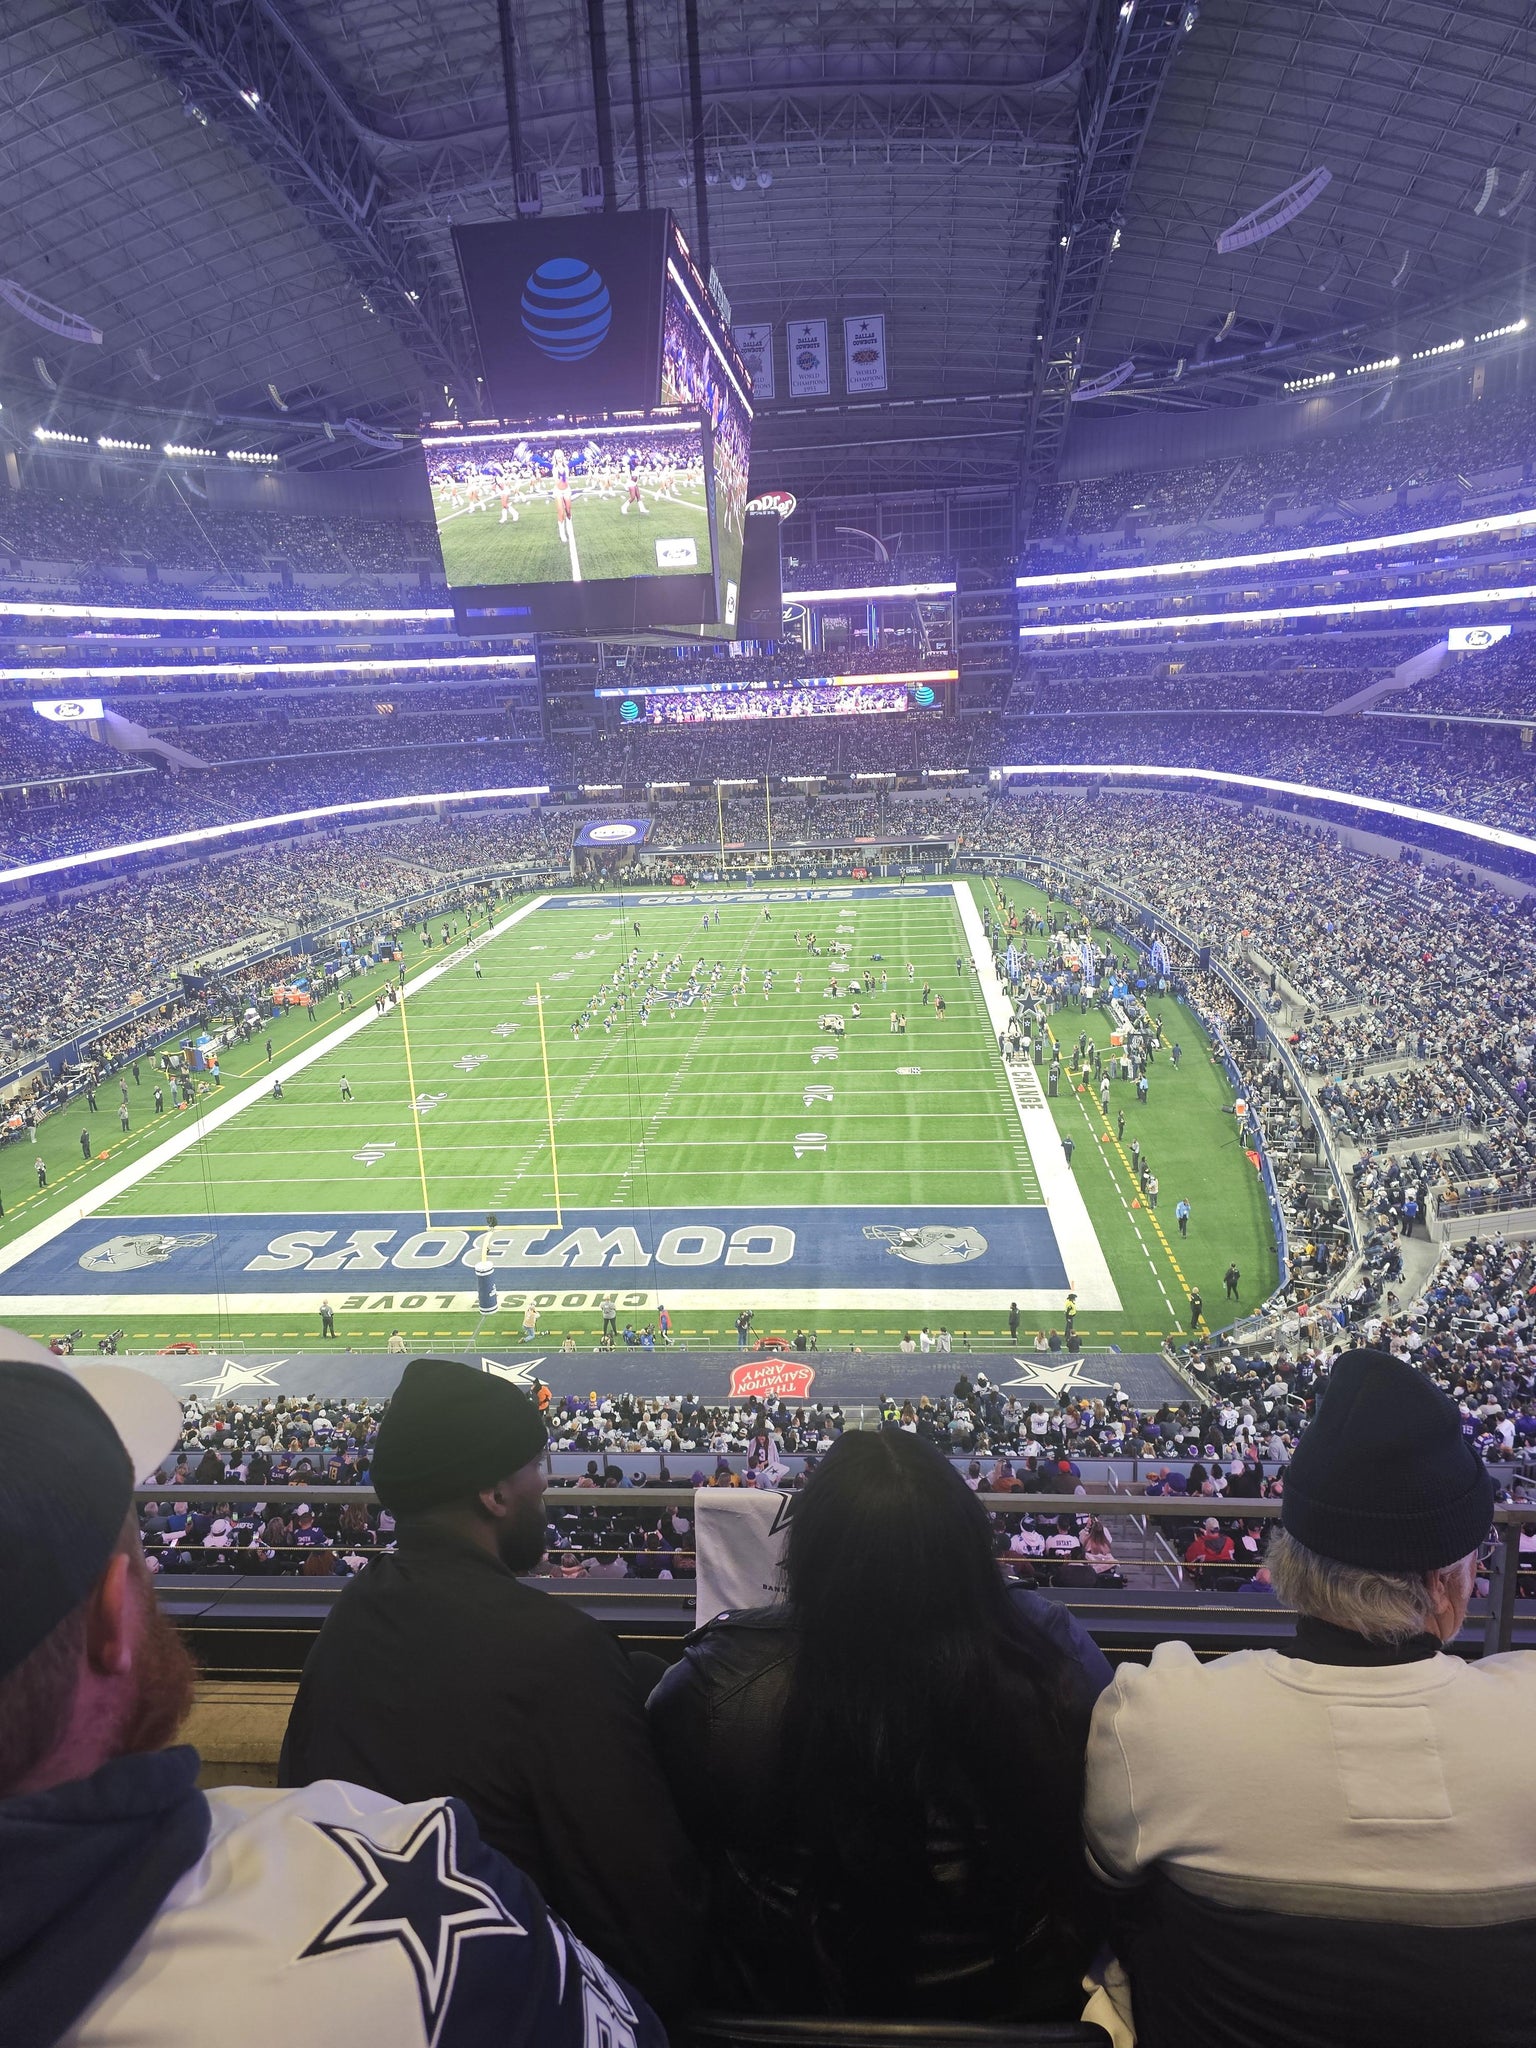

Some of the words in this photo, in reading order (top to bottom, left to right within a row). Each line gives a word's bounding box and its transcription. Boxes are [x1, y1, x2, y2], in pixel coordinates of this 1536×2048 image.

[852, 338, 878, 346] COWBOYS
[793, 380, 826, 388] CHAMPIONS
[850, 375, 884, 384] CHAMPIONS
[810, 1046, 839, 1060] 30
[803, 1084, 835, 1102] 20
[1011, 1071, 1044, 1110] CHANGE
[407, 1092, 448, 1109] 20
[352, 1141, 398, 1160] 10
[793, 1132, 828, 1152] 10
[243, 1225, 796, 1271] COWBOYS
[340, 1295, 456, 1310] LOVE
[737, 1368, 809, 1394] SALVATION
[742, 1363, 786, 1382] ARMY
[764, 1382, 796, 1396] THE
